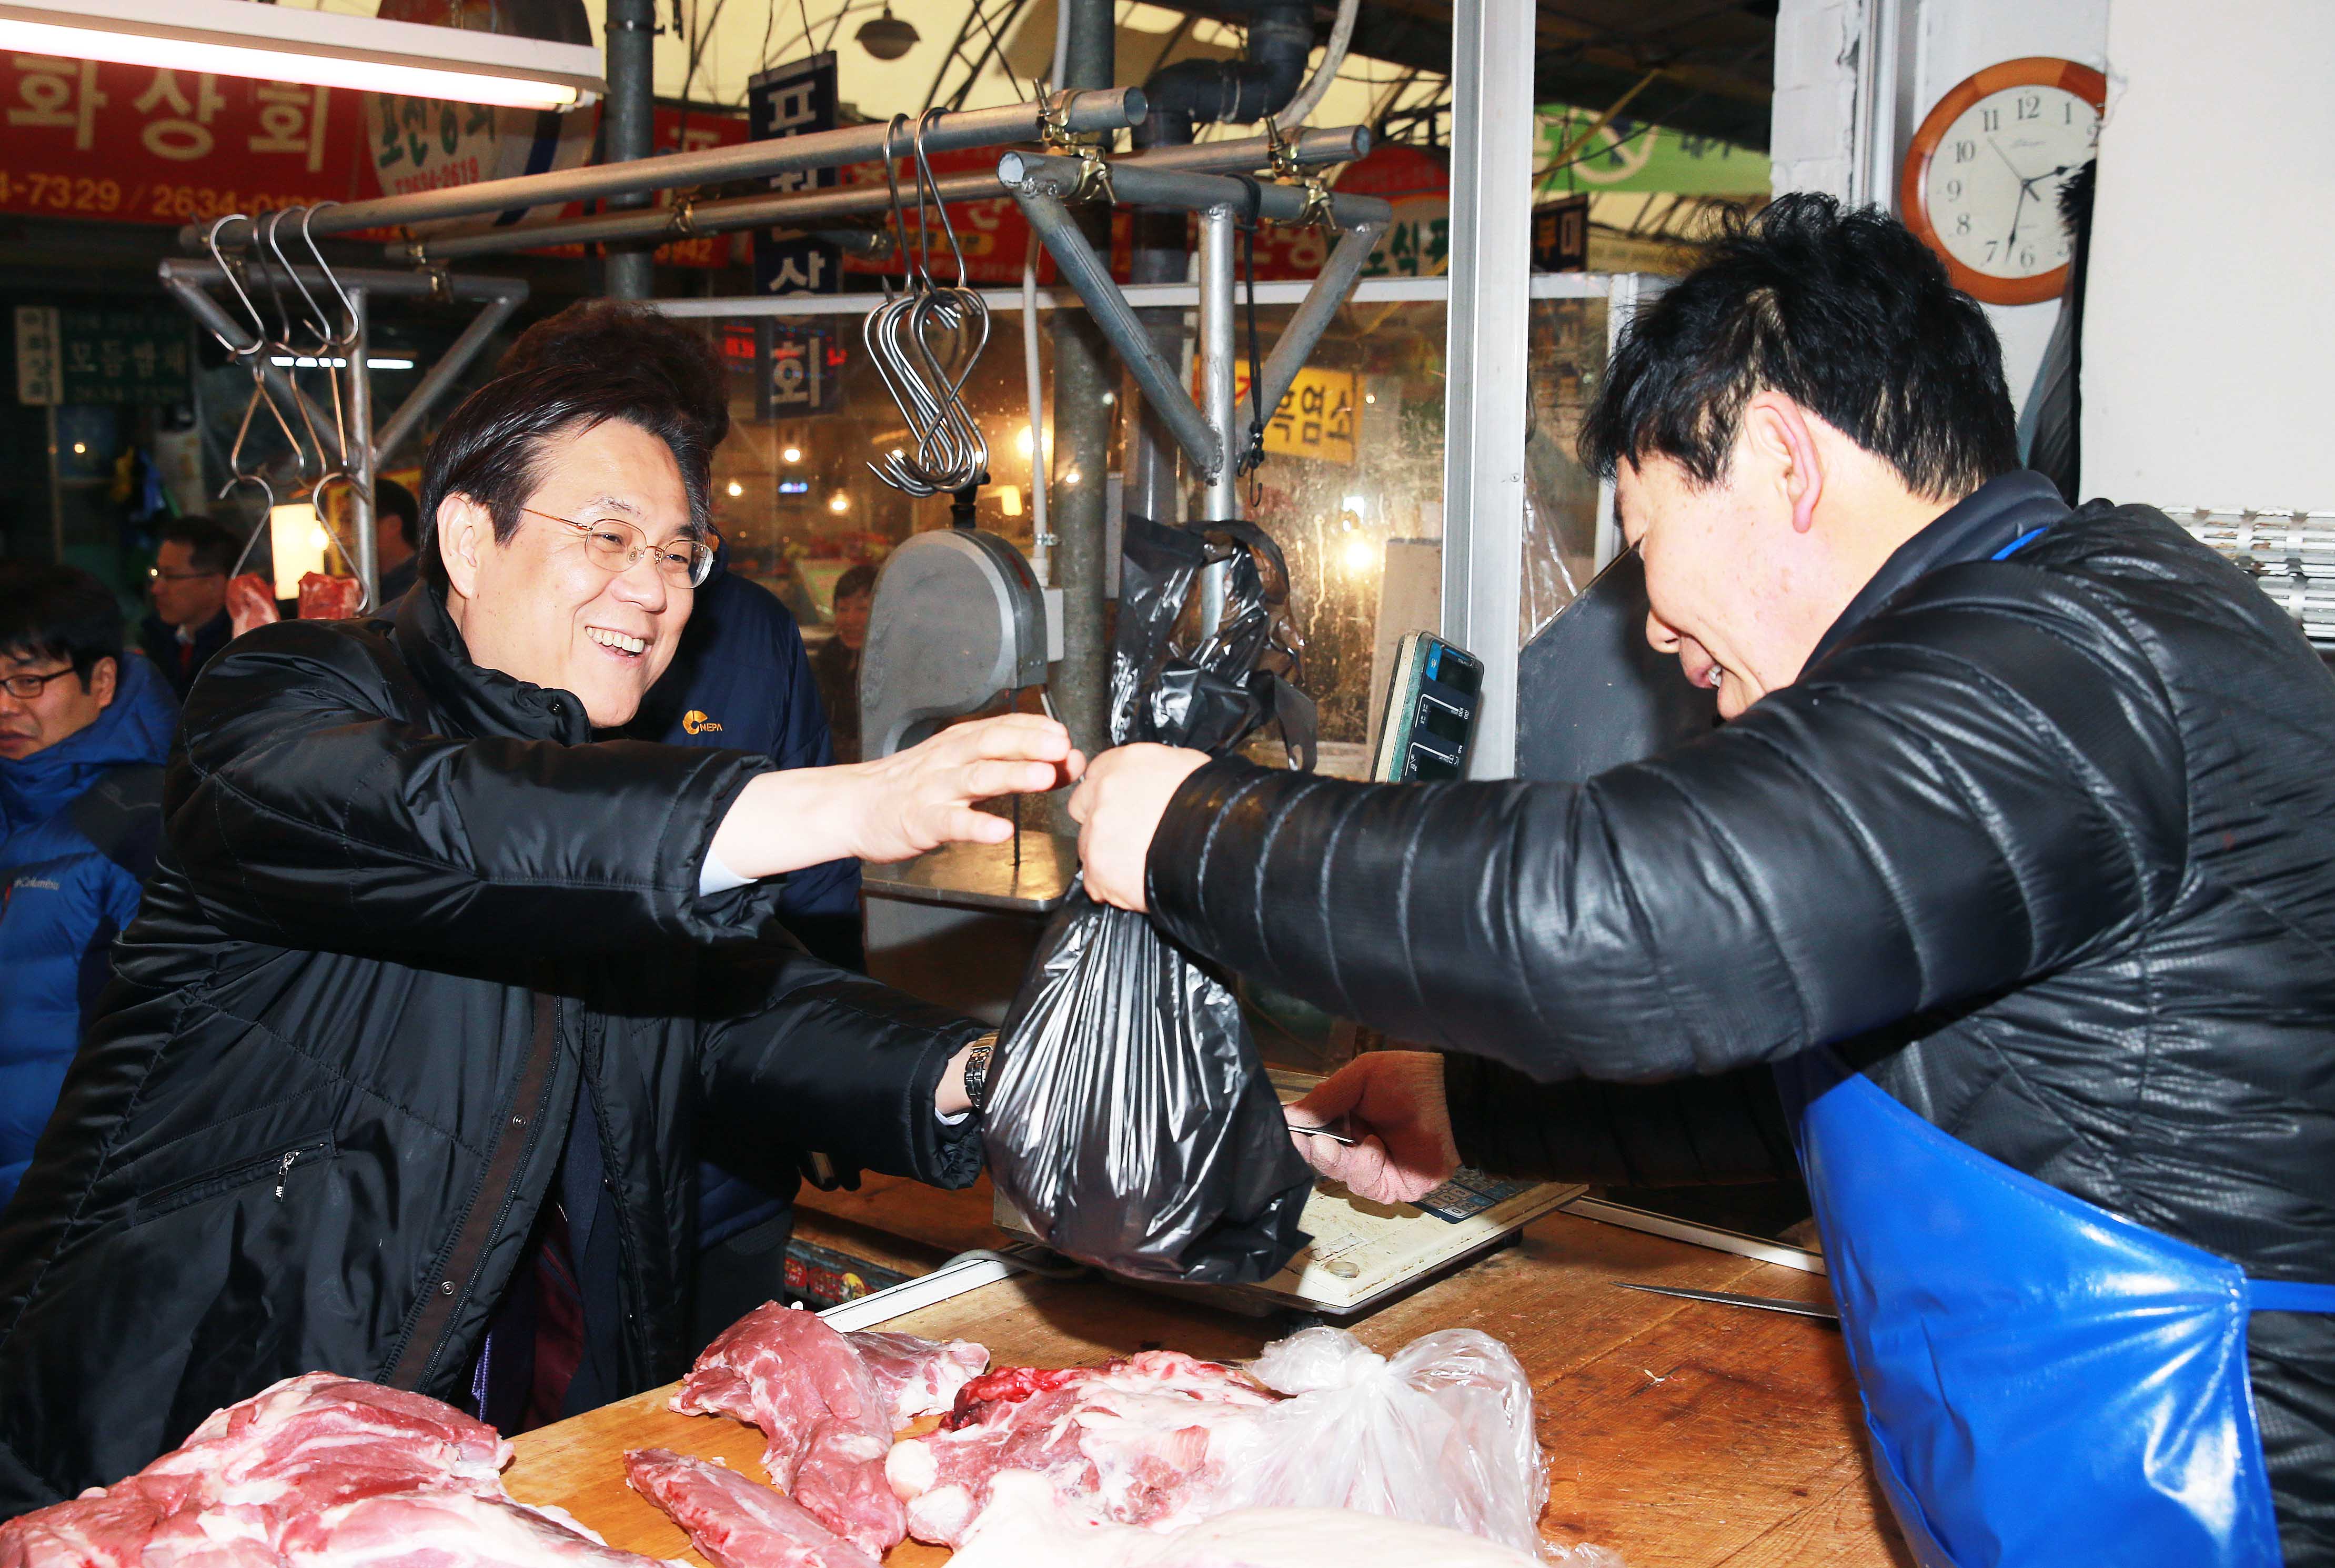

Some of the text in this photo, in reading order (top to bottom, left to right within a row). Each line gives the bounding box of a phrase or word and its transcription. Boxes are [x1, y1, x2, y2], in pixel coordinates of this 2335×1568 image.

[2016, 96, 2040, 120] 12
[2064, 102, 2072, 125] 1
[1981, 109, 1999, 132] 11
[1954, 142, 1976, 164] 10
[1947, 181, 1962, 202] 9
[1957, 214, 1971, 235] 8
[1984, 240, 1999, 263] 7
[2019, 245, 2035, 268] 6
[700, 723, 723, 731] NEPA
